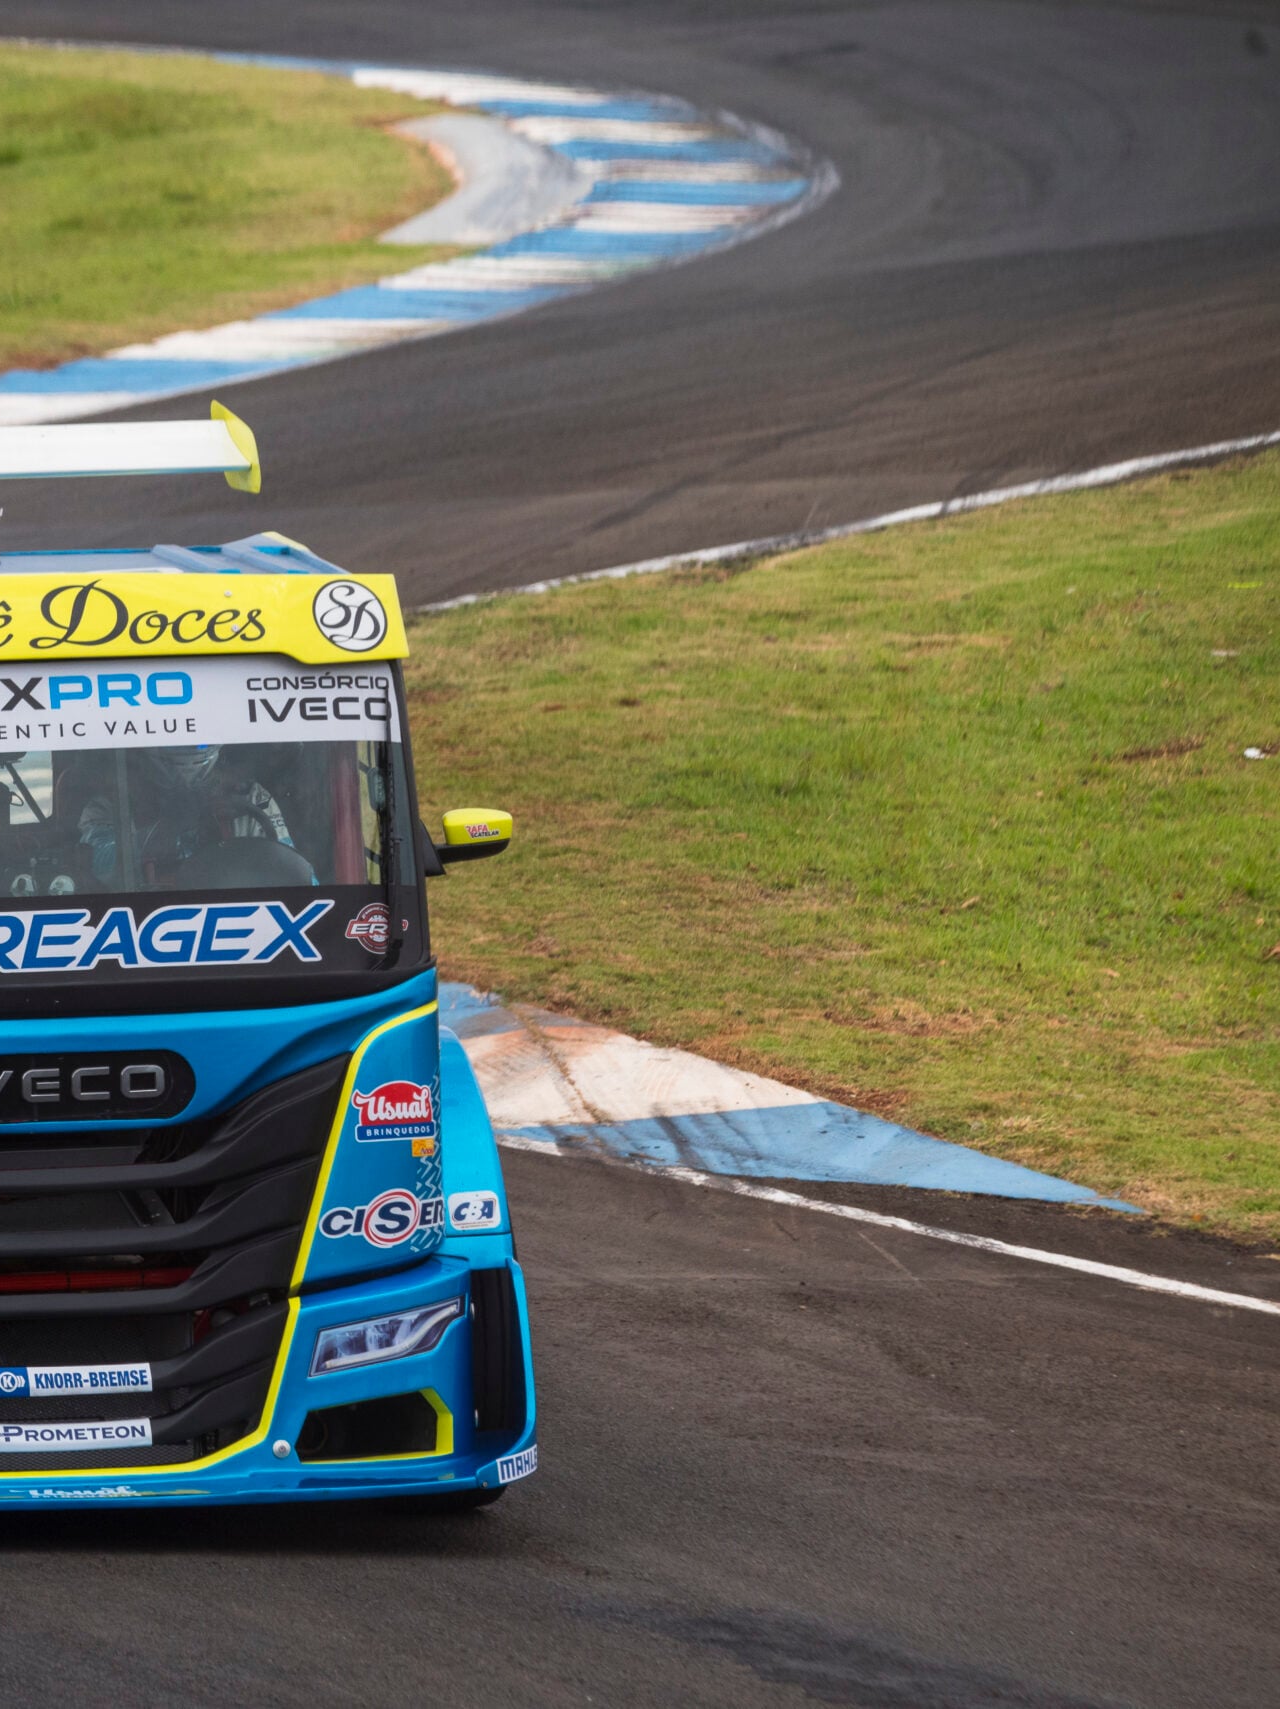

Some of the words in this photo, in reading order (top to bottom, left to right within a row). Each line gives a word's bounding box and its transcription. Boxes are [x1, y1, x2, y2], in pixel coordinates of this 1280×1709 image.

[29, 579, 266, 649] Doces
[247, 671, 389, 691] CONSÓRCIO
[248, 696, 392, 723] IVECO
[104, 718, 197, 735] VALUE
[351, 923, 389, 935] ER
[355, 1089, 430, 1121] Usual
[366, 1125, 430, 1137] BRINQUEDOS
[453, 1199, 495, 1220] CBA
[34, 1369, 149, 1390] KNORR-BREMSE
